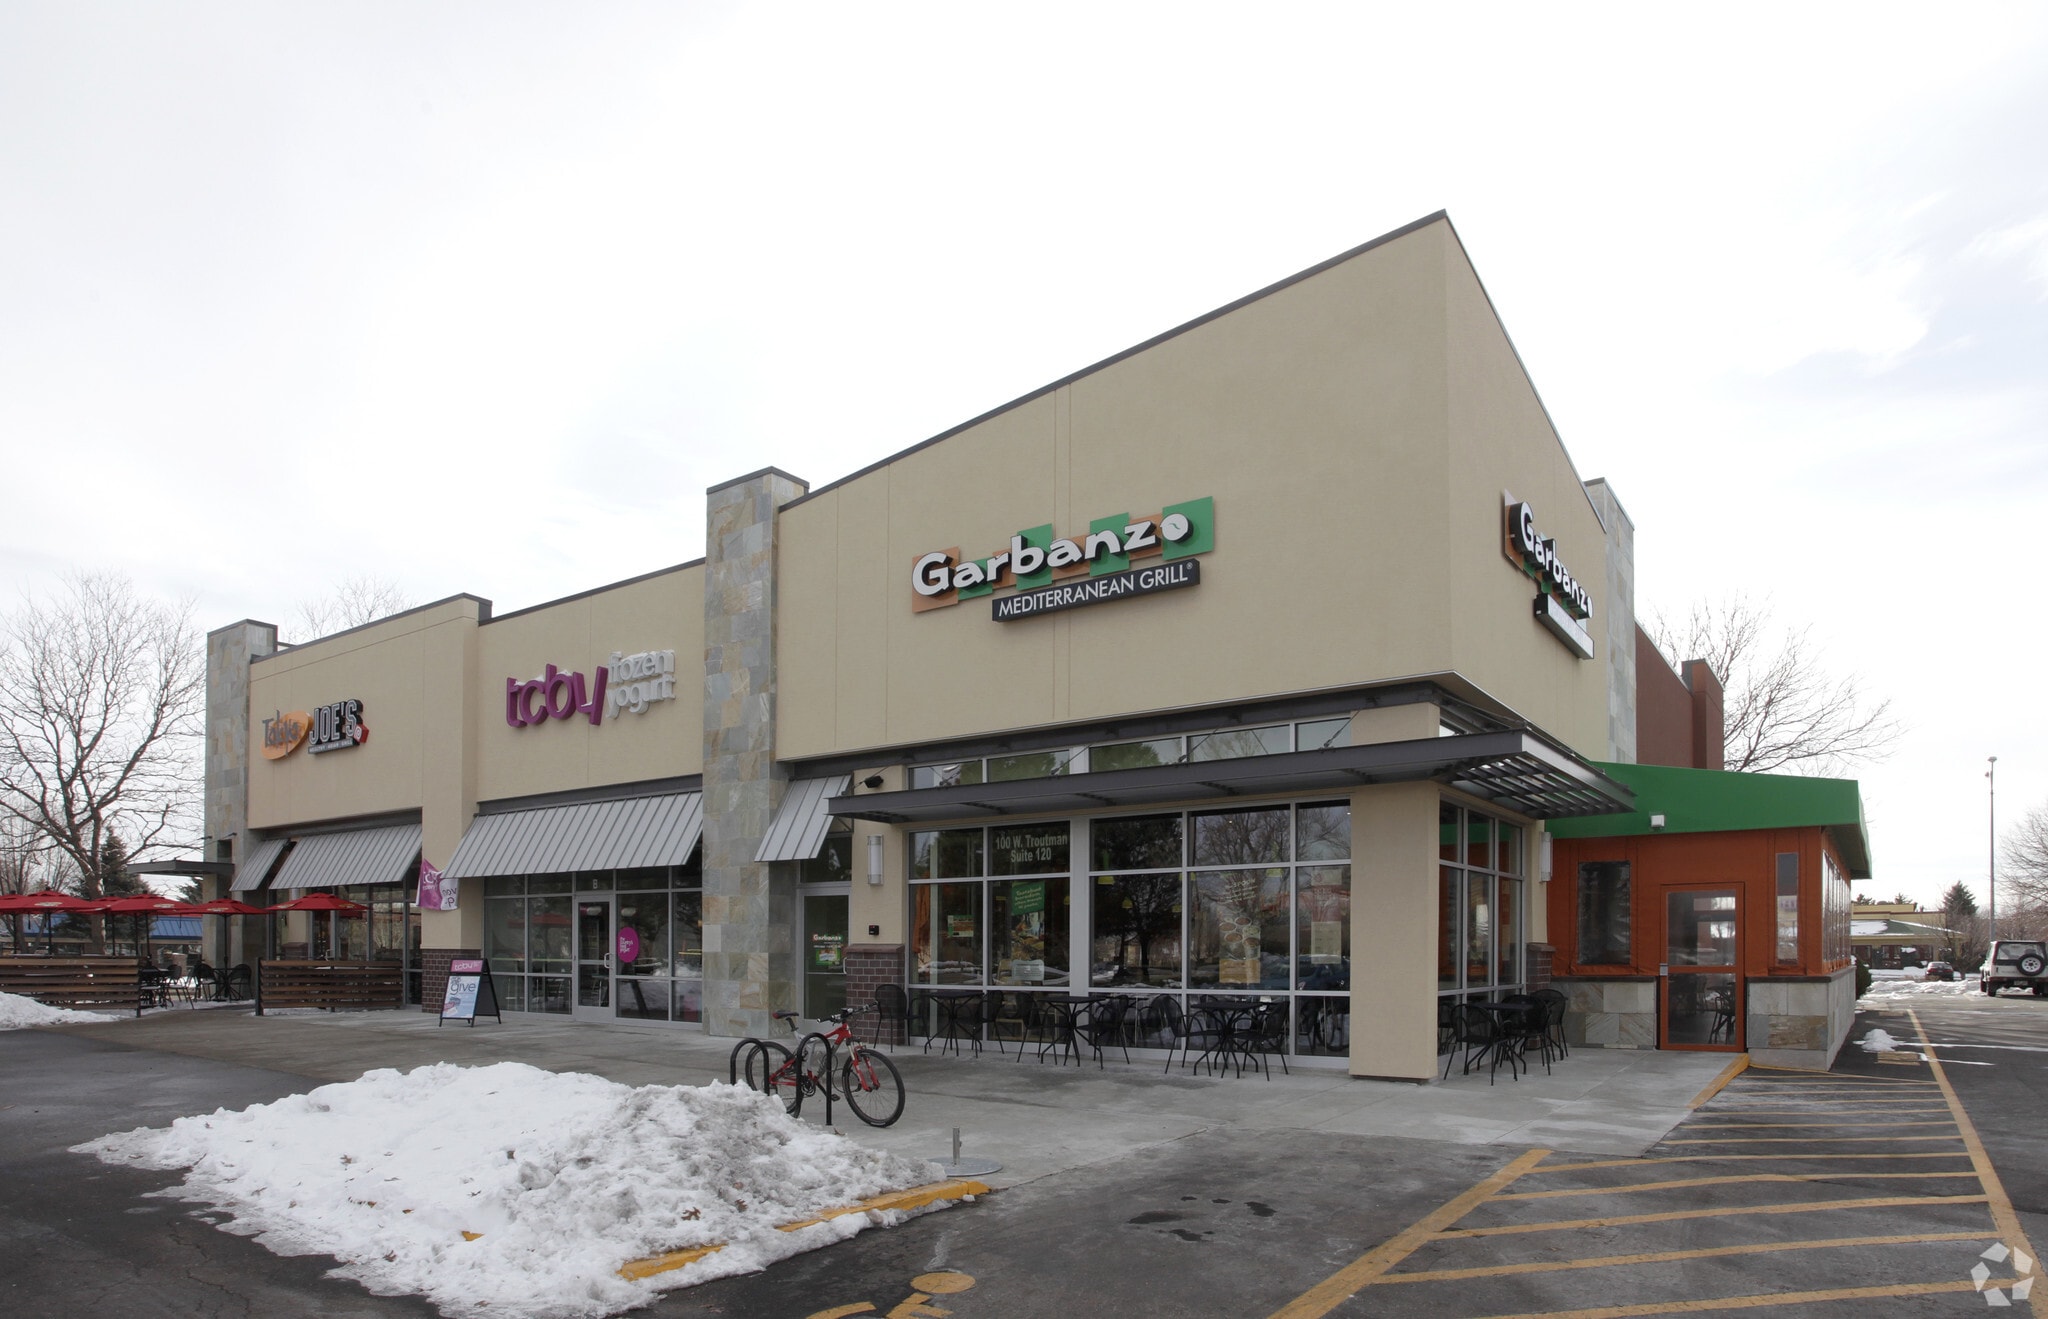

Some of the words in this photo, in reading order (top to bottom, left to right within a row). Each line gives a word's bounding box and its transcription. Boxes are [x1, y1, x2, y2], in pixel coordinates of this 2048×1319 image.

[912, 513, 1193, 596] Garbanzo
[1513, 502, 1594, 619] Garbanzo
[998, 574, 1134, 617] MEDITERRANEAN
[608, 650, 675, 684] frozen
[507, 663, 608, 728] tcby
[606, 674, 676, 720] yogurt
[309, 699, 360, 745] JOE'S
[996, 834, 1011, 850] 100
[1025, 834, 1068, 848] Troutman
[1011, 849, 1033, 862] Suite
[1035, 847, 1052, 861] 120
[450, 982, 477, 995] give
